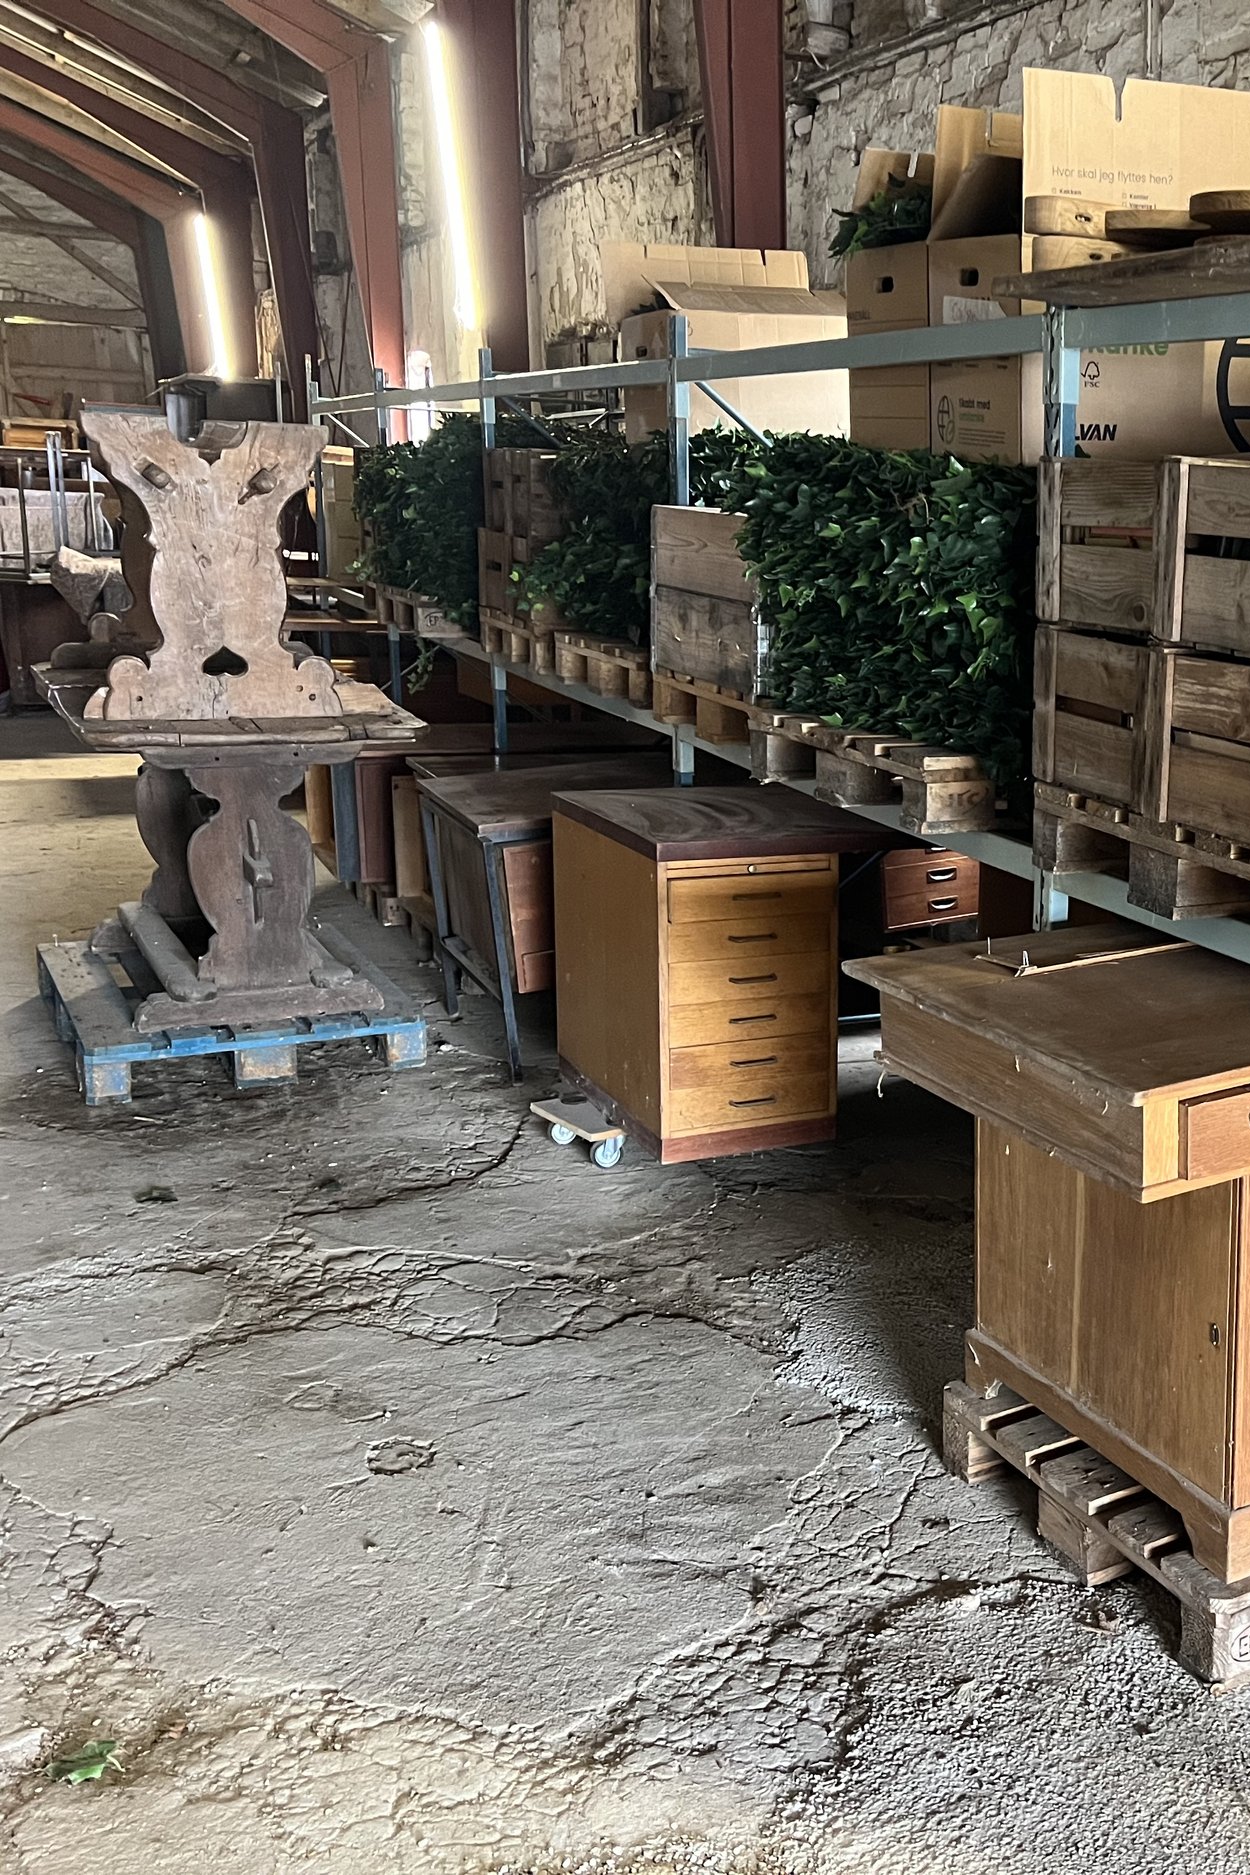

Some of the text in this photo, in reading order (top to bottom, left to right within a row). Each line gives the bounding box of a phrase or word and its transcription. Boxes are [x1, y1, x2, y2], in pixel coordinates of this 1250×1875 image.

[1052, 166, 1174, 185] Hvor skal jeg flyttes hen?
